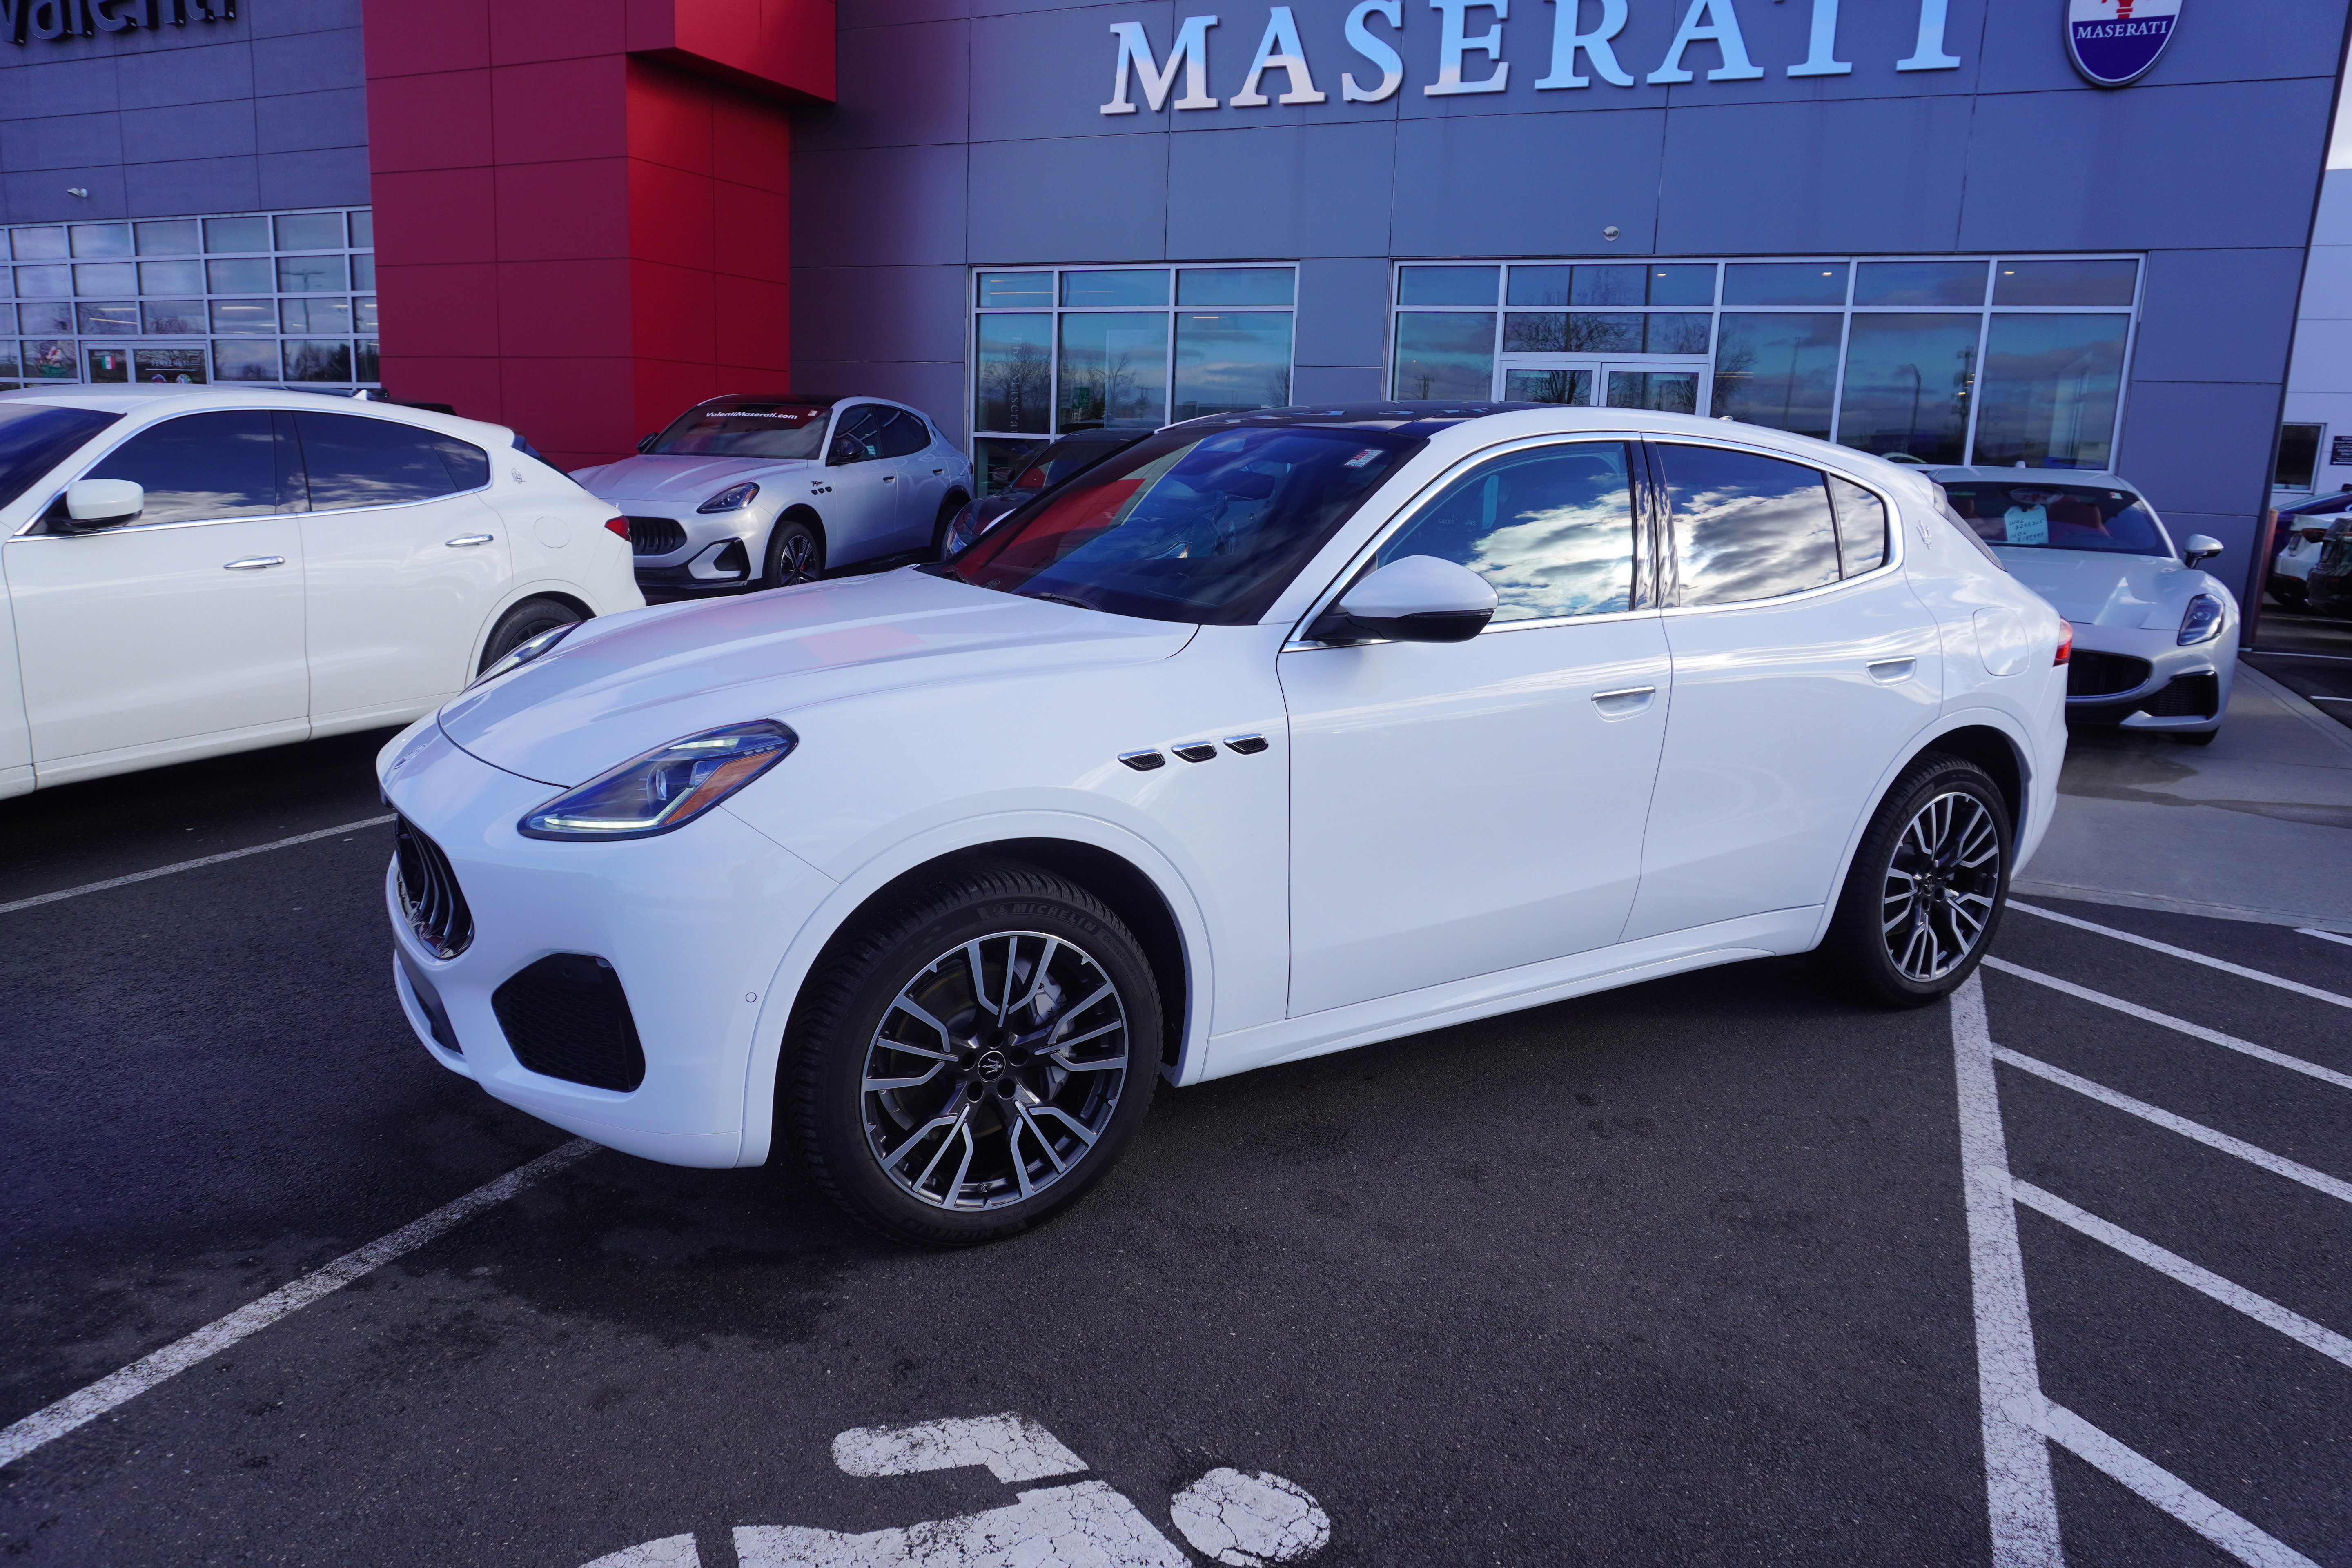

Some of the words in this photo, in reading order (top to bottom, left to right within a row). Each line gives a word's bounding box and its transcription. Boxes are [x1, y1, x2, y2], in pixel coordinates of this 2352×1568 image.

[0, 0, 231, 43] Valen
[2076, 21, 2168, 39] MASERATI
[1100, 0, 1961, 115] MASERATI
[706, 412, 798, 420] ValentiMaserati.com
[2009, 518, 2025, 526] WAS
[2010, 530, 2028, 539] NOW
[1012, 903, 1097, 933] MICHELIN
[905, 1219, 995, 1240] MICHELIN
